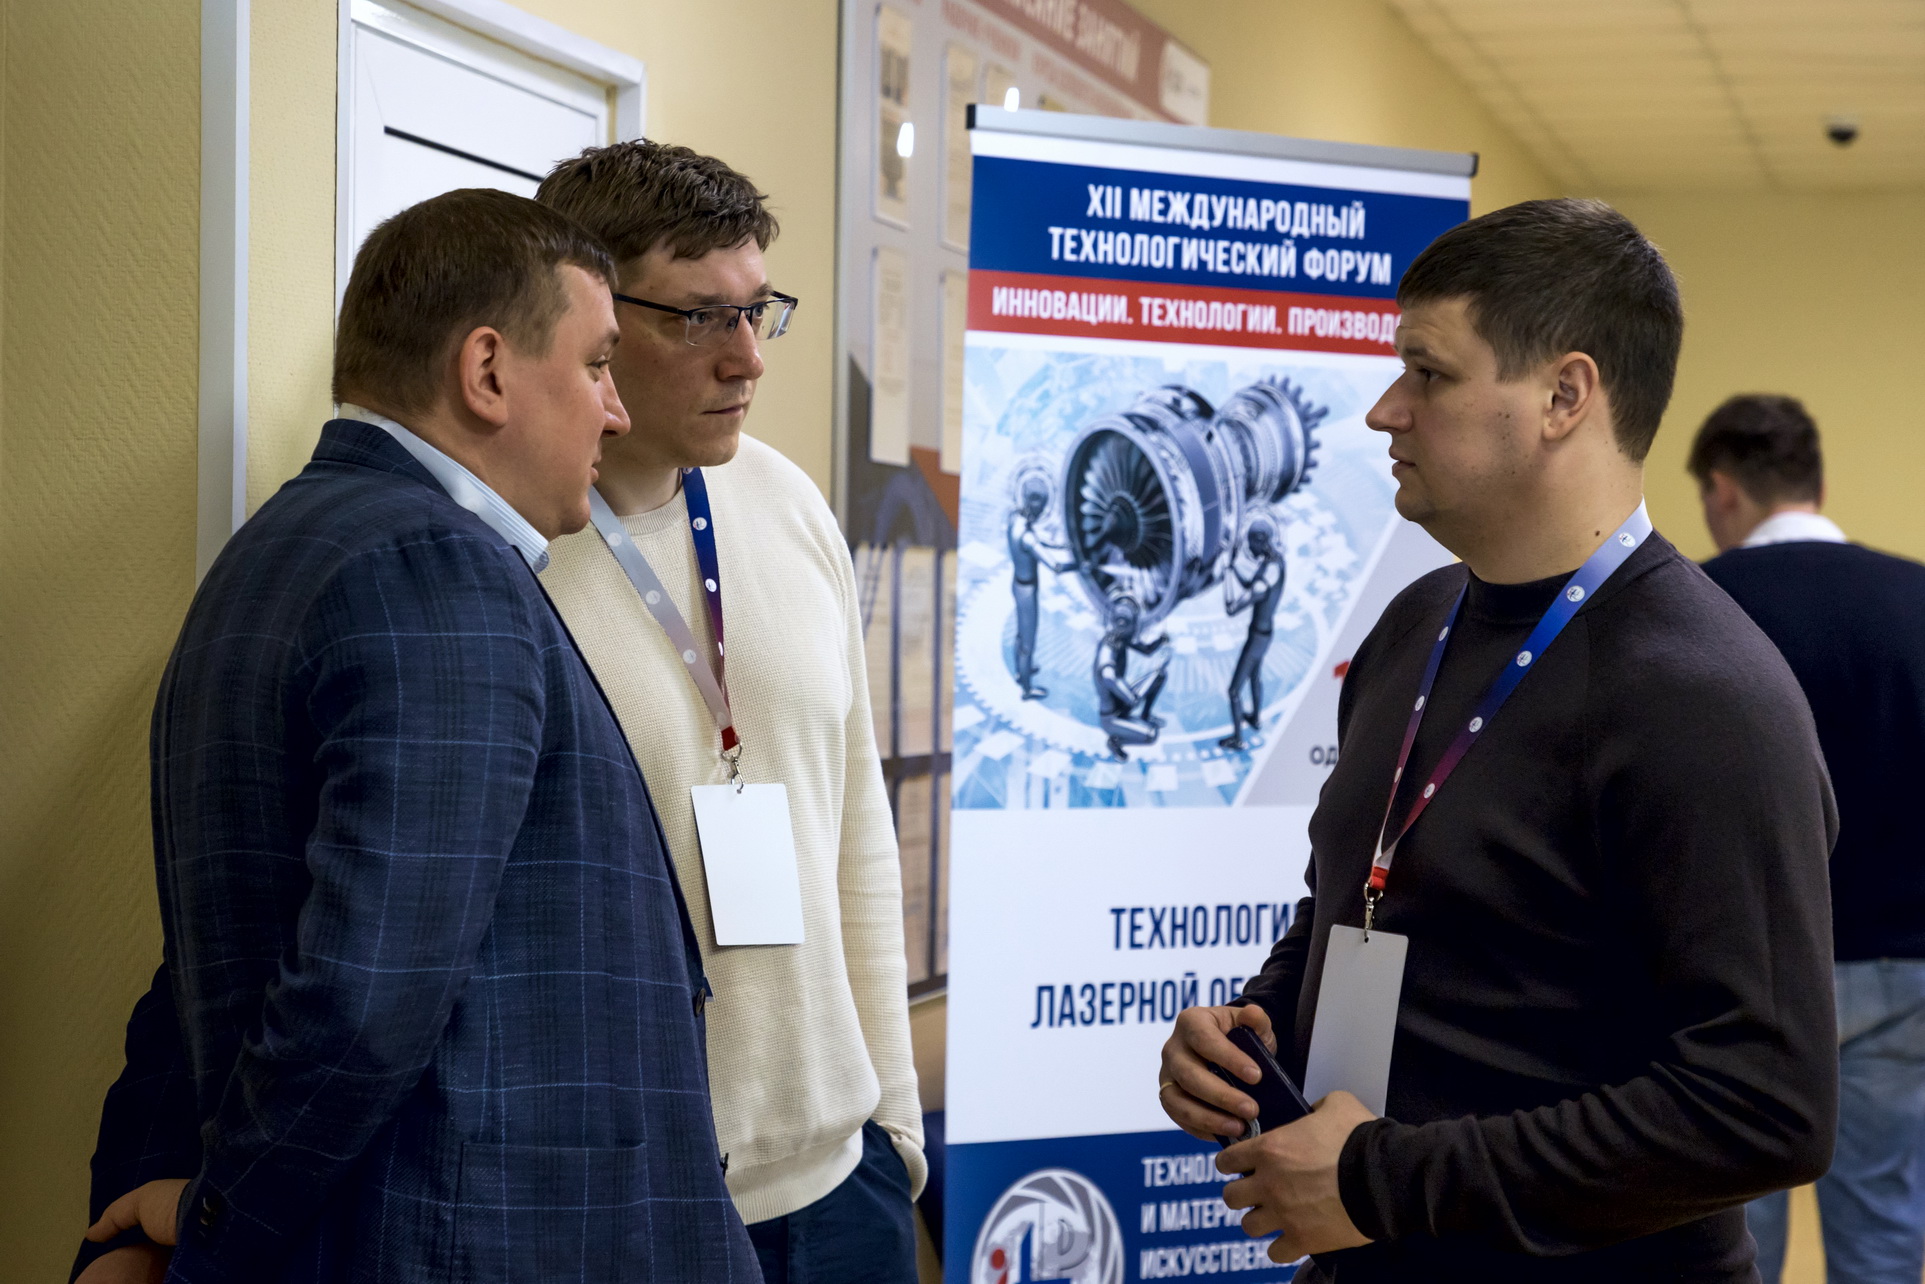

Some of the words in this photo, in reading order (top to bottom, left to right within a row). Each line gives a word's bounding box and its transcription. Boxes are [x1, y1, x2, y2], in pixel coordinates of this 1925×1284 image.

[1129, 187, 1366, 240] МЕЖДУНАРОДНЫЙ
[1048, 227, 1297, 278] ТЕХНОЛОГИЧЕСКИЙ
[1303, 248, 1392, 286] ФОРУМ
[992, 287, 1133, 326] ИННОВАЦИИ.
[1139, 297, 1282, 335] ТЕХНОЛОГИИ.
[1109, 903, 1298, 950] ТЕХНОЛОГИ
[1030, 972, 1199, 1029] ЛАЗЕРНОЙ
[1140, 1203, 1157, 1234] И
[1159, 1197, 1255, 1232] МАТЕРИ
[1139, 1238, 1310, 1280] ИСКУССТВЕН
